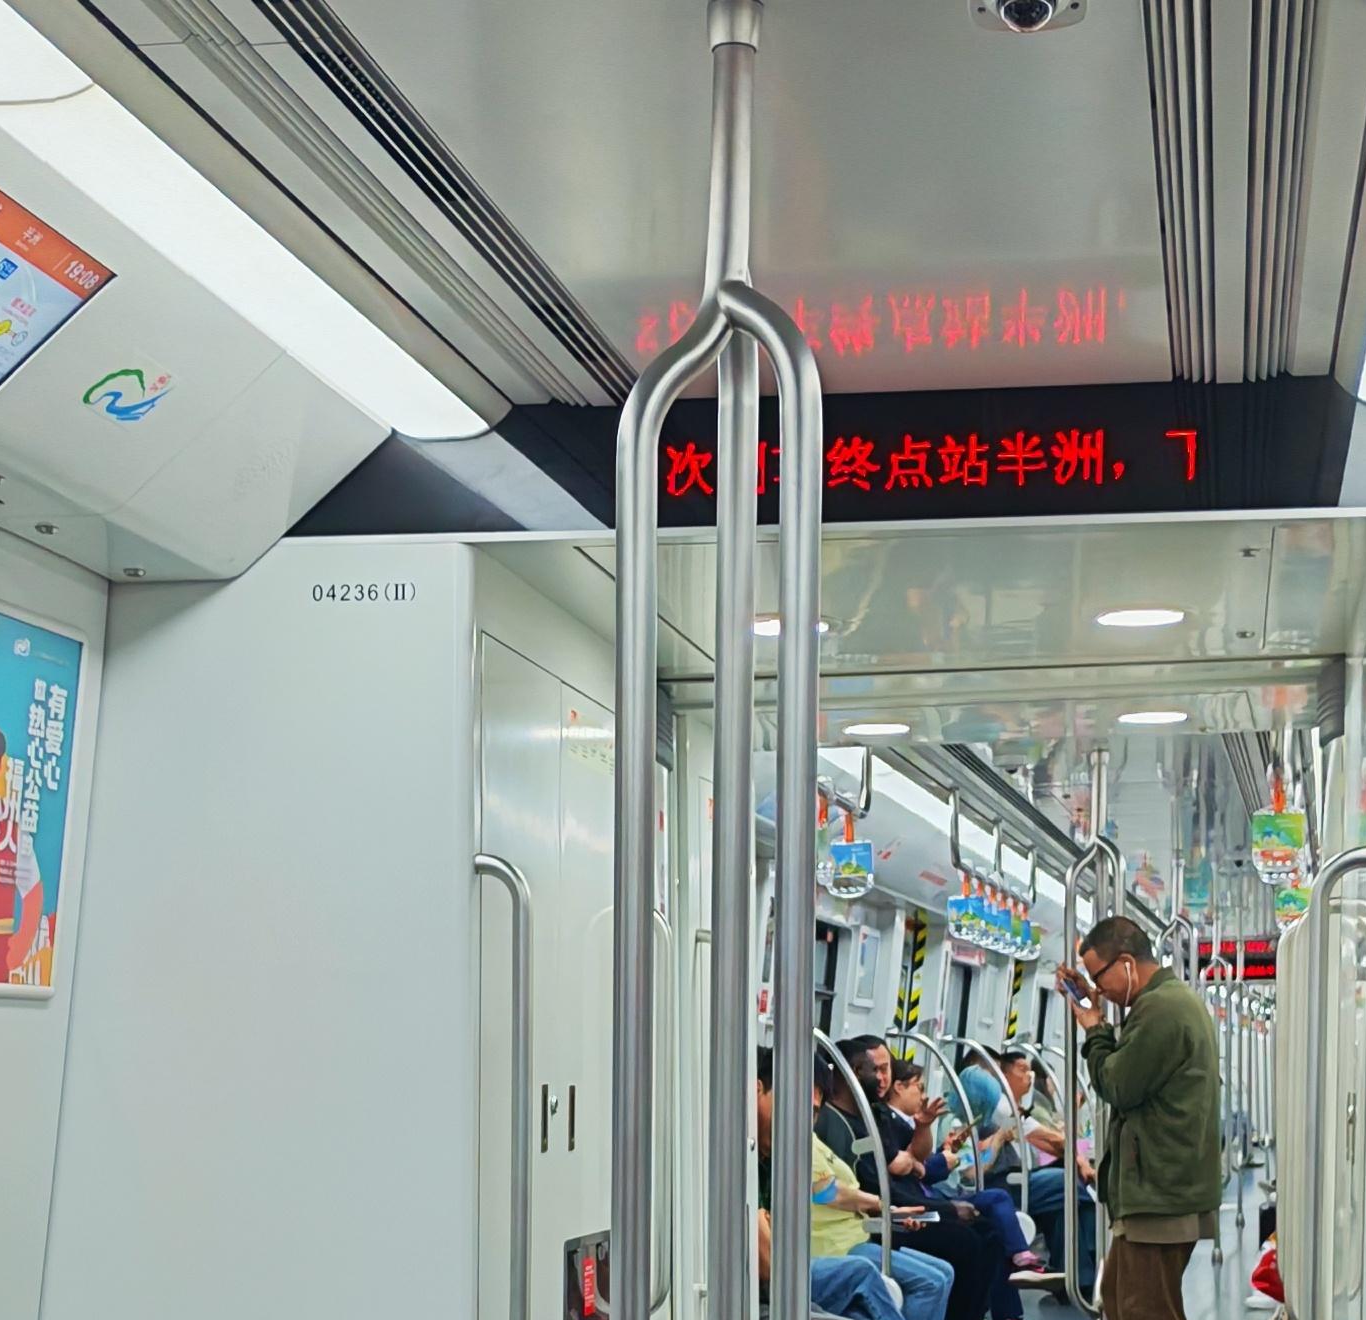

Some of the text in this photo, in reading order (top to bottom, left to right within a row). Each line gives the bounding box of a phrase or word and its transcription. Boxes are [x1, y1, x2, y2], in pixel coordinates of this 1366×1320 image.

[64, 260, 100, 290] 19:08
[665, 429, 1198, 497] 次终点站半洲，
